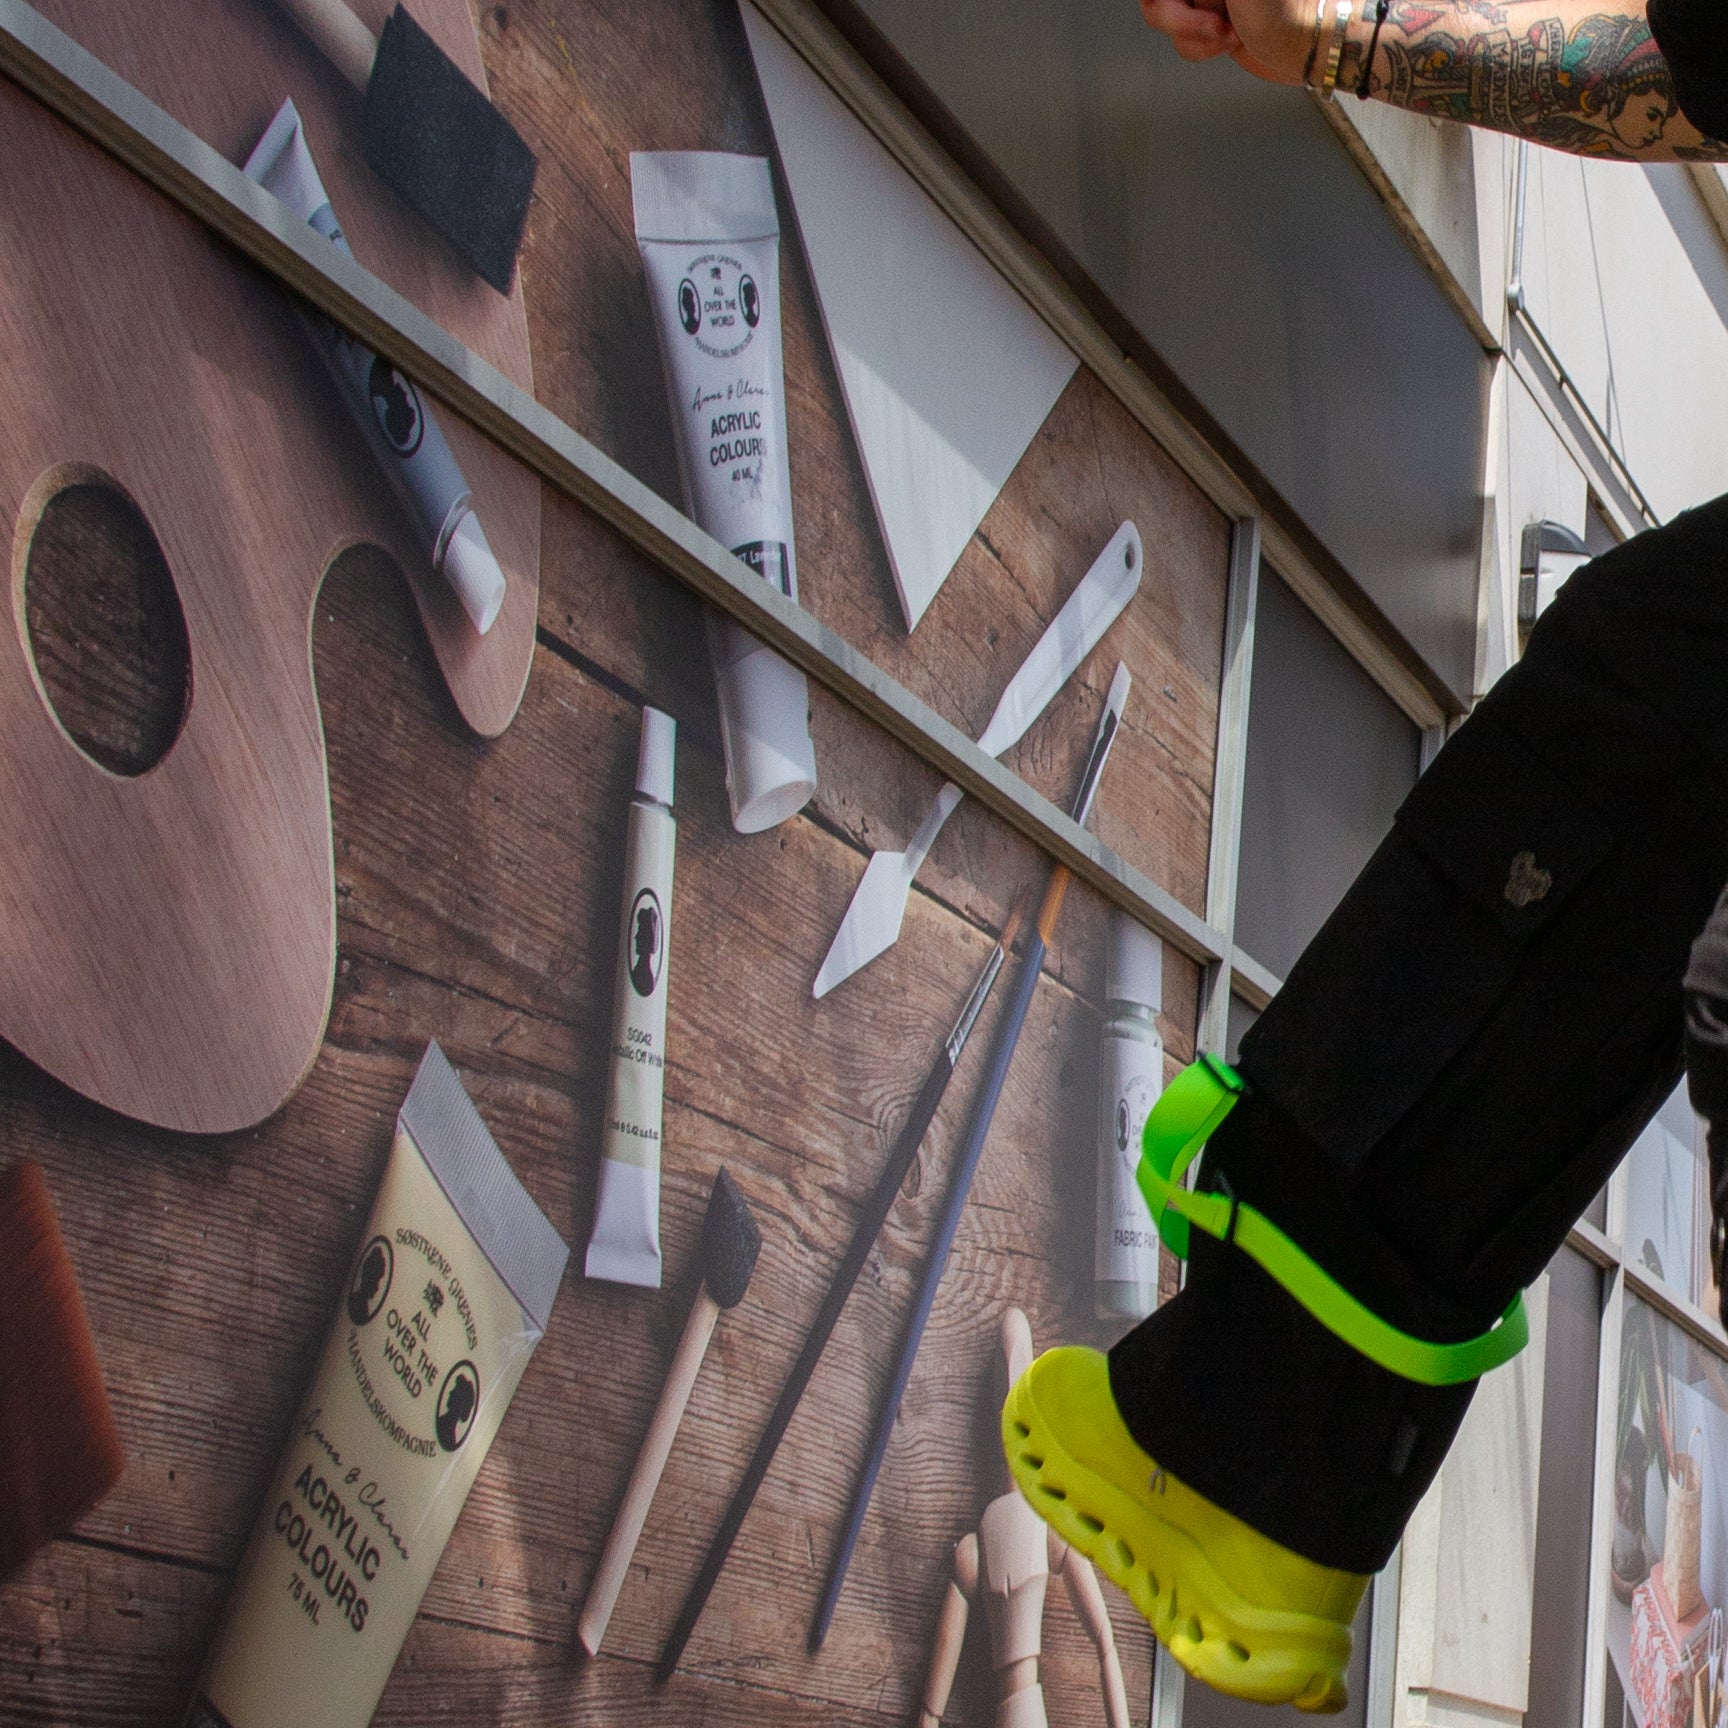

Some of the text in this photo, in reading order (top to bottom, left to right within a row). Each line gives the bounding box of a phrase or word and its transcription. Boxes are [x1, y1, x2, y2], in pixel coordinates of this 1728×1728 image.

[711, 411, 762, 439] ACRYLIC
[709, 437, 768, 467] COLOURS
[1114, 1229, 1143, 1248] FABRIC
[411, 1309, 432, 1343] ALL
[386, 1308, 439, 1387] OVER THE
[383, 1336, 423, 1399] WORLD
[294, 1463, 381, 1582] ACRYLIC
[274, 1499, 369, 1633] COLOURS
[302, 1590, 321, 1626] ML
